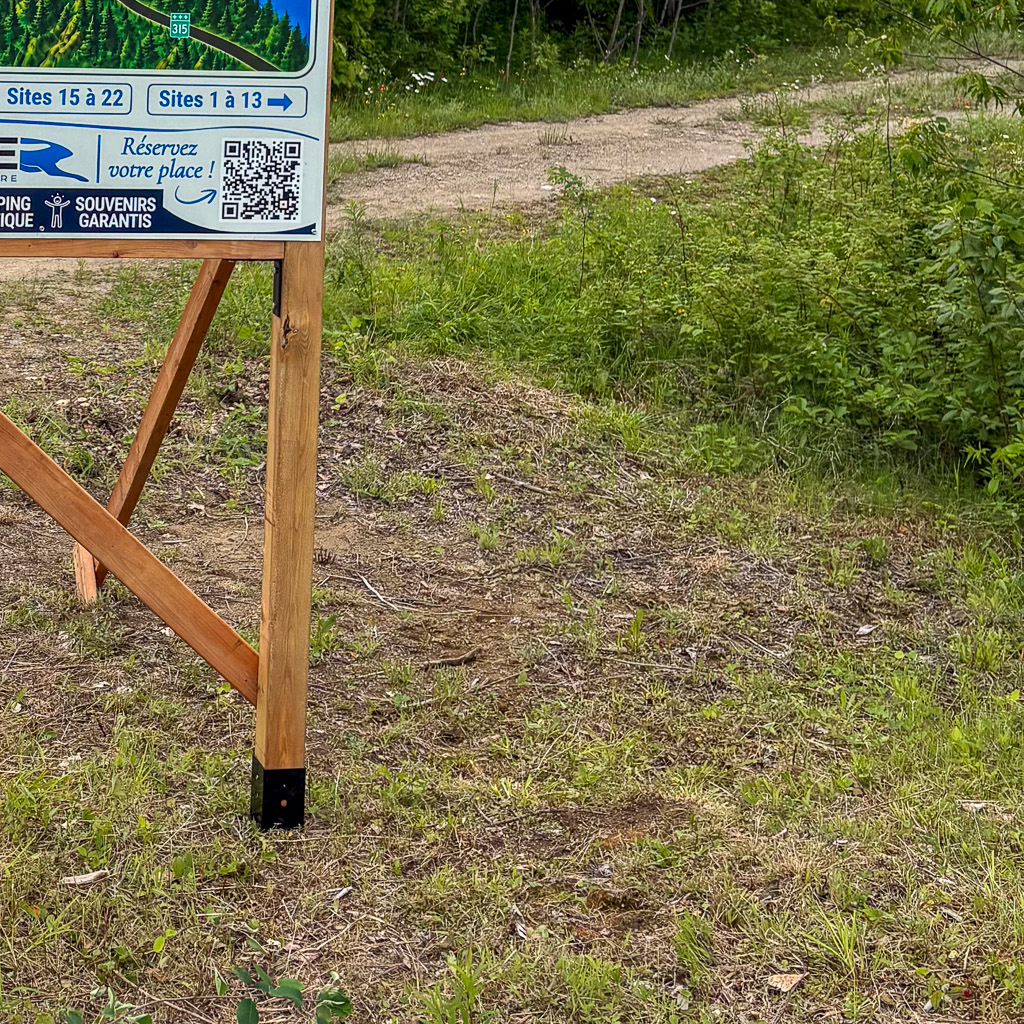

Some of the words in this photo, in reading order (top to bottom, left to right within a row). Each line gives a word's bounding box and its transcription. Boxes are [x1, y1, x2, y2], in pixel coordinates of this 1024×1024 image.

[171, 24, 188, 35] 315
[7, 87, 52, 106] Sites
[59, 89, 80, 106] 15
[86, 90, 95, 106] à
[102, 90, 124, 106] 22
[159, 90, 203, 108] Sites
[210, 92, 217, 108] 1
[225, 92, 235, 108] à
[242, 92, 262, 108] 13
[120, 135, 198, 156] Réservez
[108, 164, 154, 178] votre
[157, 159, 203, 184] place
[76, 196, 156, 212] SOUVENIRS
[78, 212, 152, 228] GARANTIS
